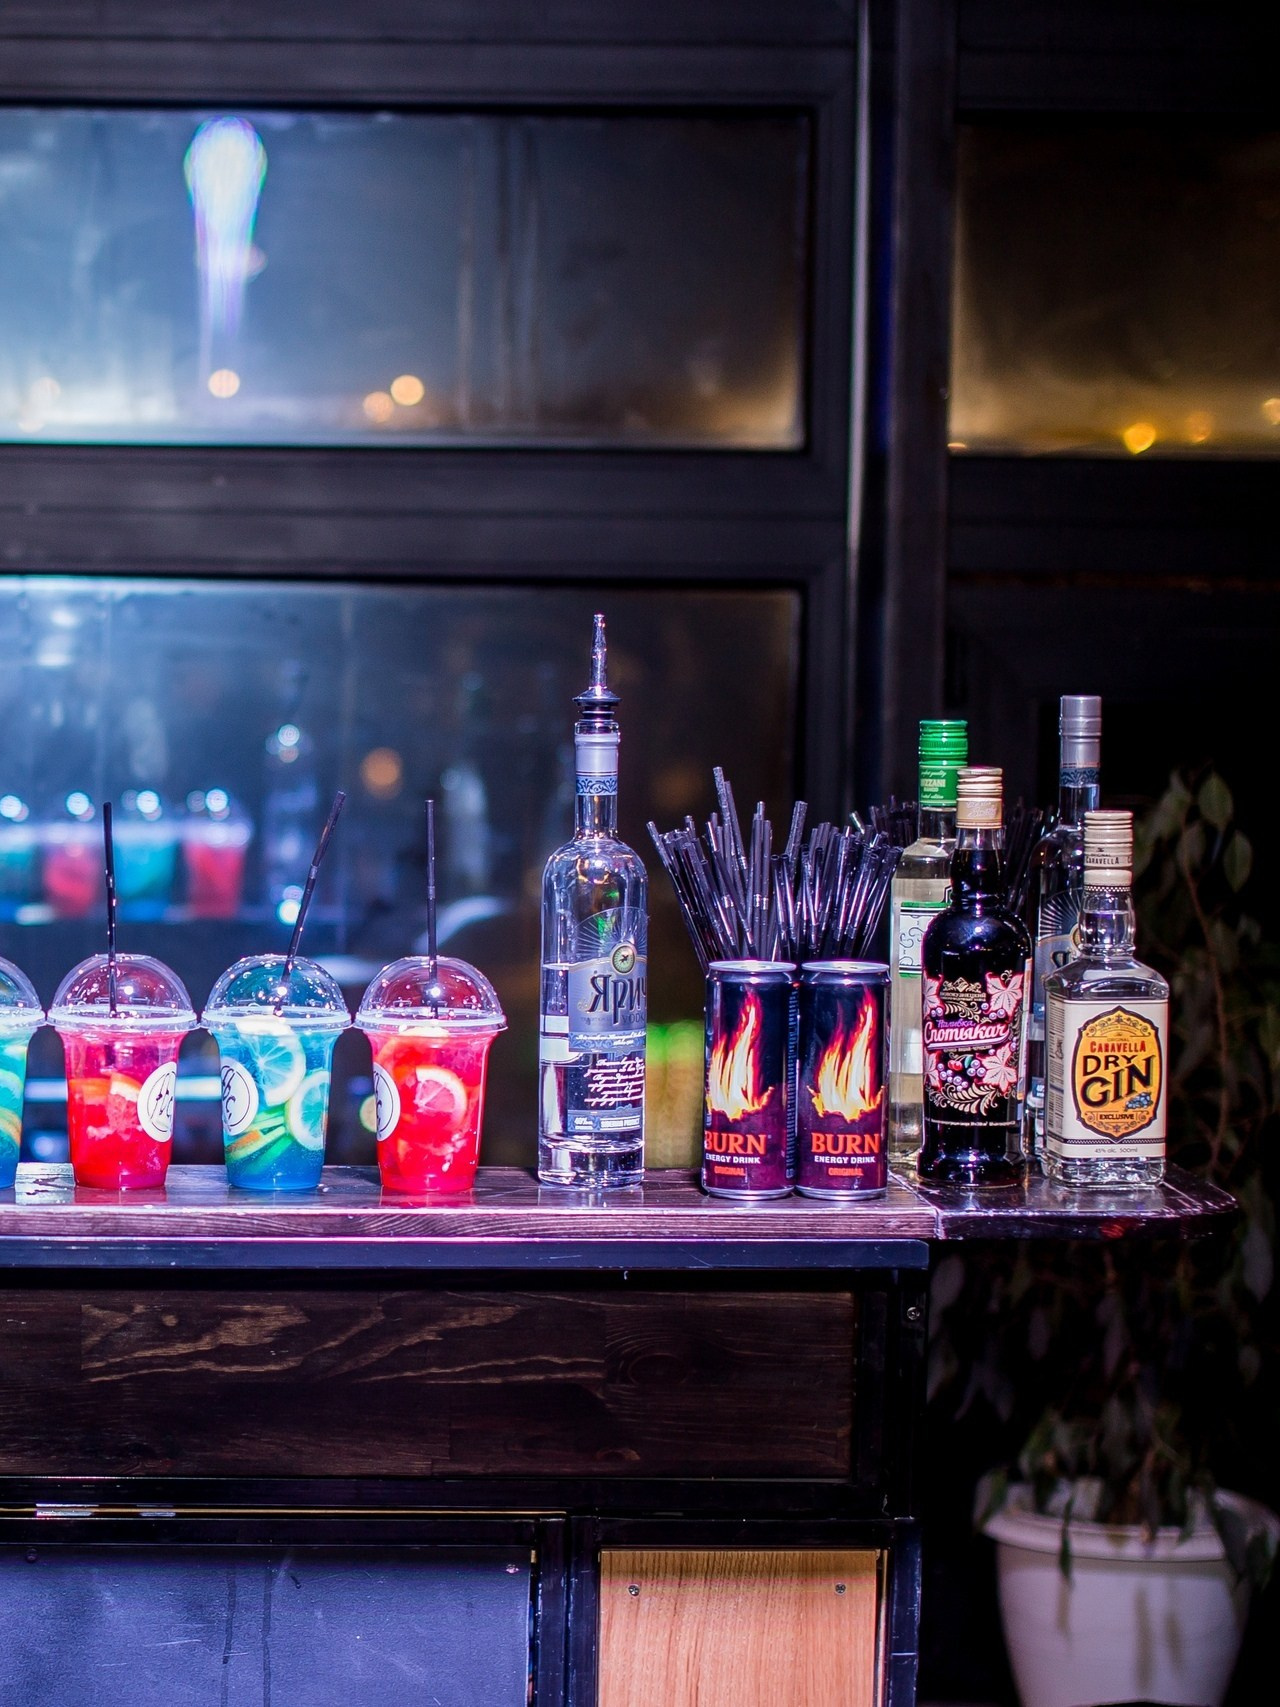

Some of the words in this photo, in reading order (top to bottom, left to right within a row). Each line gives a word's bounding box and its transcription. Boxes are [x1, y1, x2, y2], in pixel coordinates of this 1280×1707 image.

[1086, 856, 1119, 865] CARAVELLA
[1090, 1040, 1146, 1053] CARAVELLA
[1083, 1055, 1138, 1077] DRY
[1081, 1055, 1157, 1107] GIN
[704, 1130, 767, 1155] BURN
[811, 1132, 880, 1155] BURN
[706, 1152, 731, 1163] ENERGY
[733, 1155, 761, 1164] DRINK
[814, 1155, 849, 1164] ENERGY
[850, 1155, 876, 1164] DRINK
